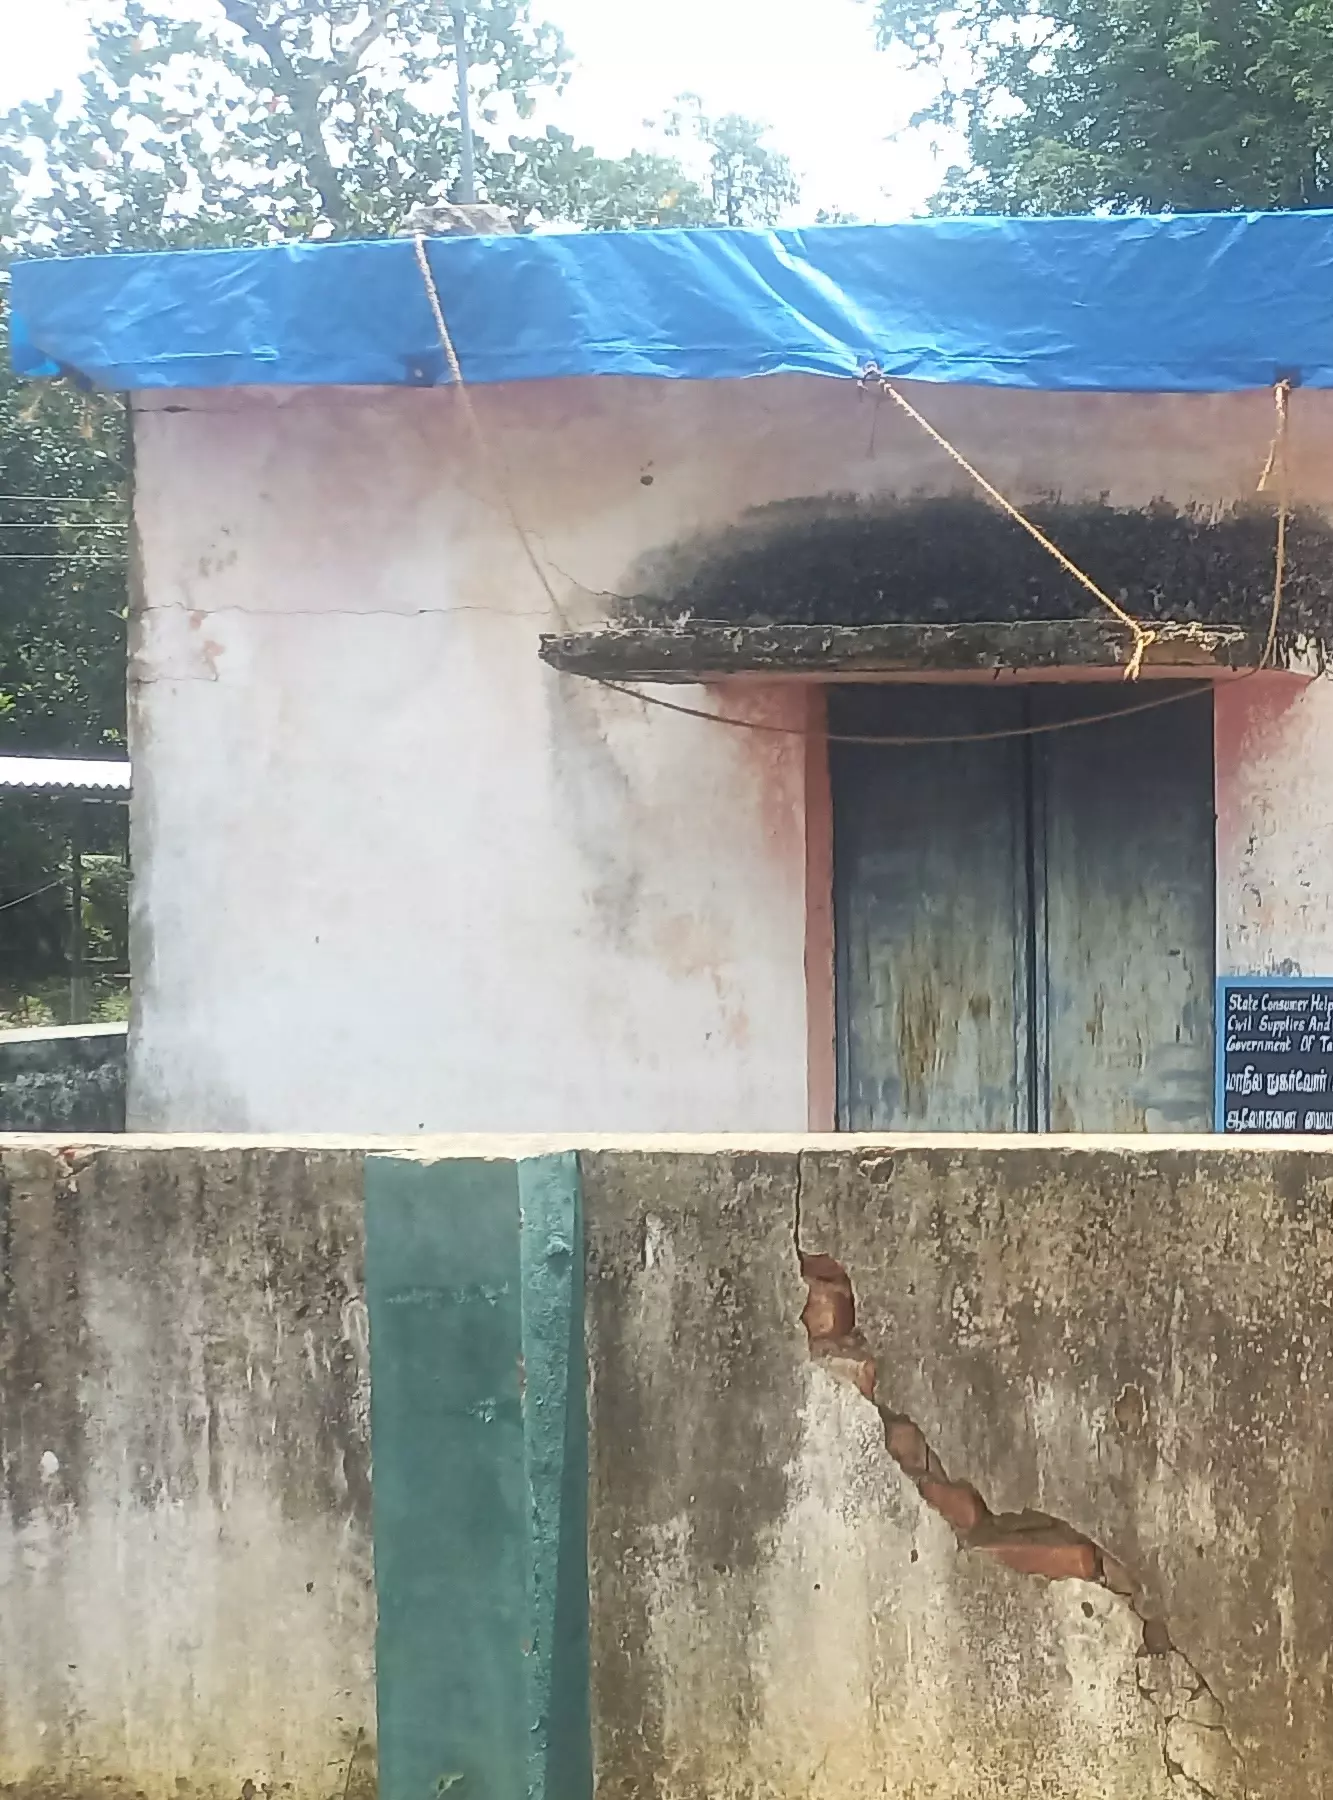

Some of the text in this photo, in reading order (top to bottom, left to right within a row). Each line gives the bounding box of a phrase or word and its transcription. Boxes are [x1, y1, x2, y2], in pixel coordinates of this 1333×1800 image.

[1228, 993, 1259, 1012] State
[1261, 993, 1309, 1012] Consumer
[1227, 1014, 1252, 1032] Civil
[1258, 1014, 1306, 1039] Supplies
[1307, 1015, 1332, 1032] And
[1225, 1034, 1292, 1053] Government
[1299, 1034, 1316, 1053] Of
[1225, 1064, 1263, 1096] மாநில
[1266, 1068, 1328, 1096] நுகர்வோர்
[1225, 1107, 1298, 1133] ஆலோசனை
